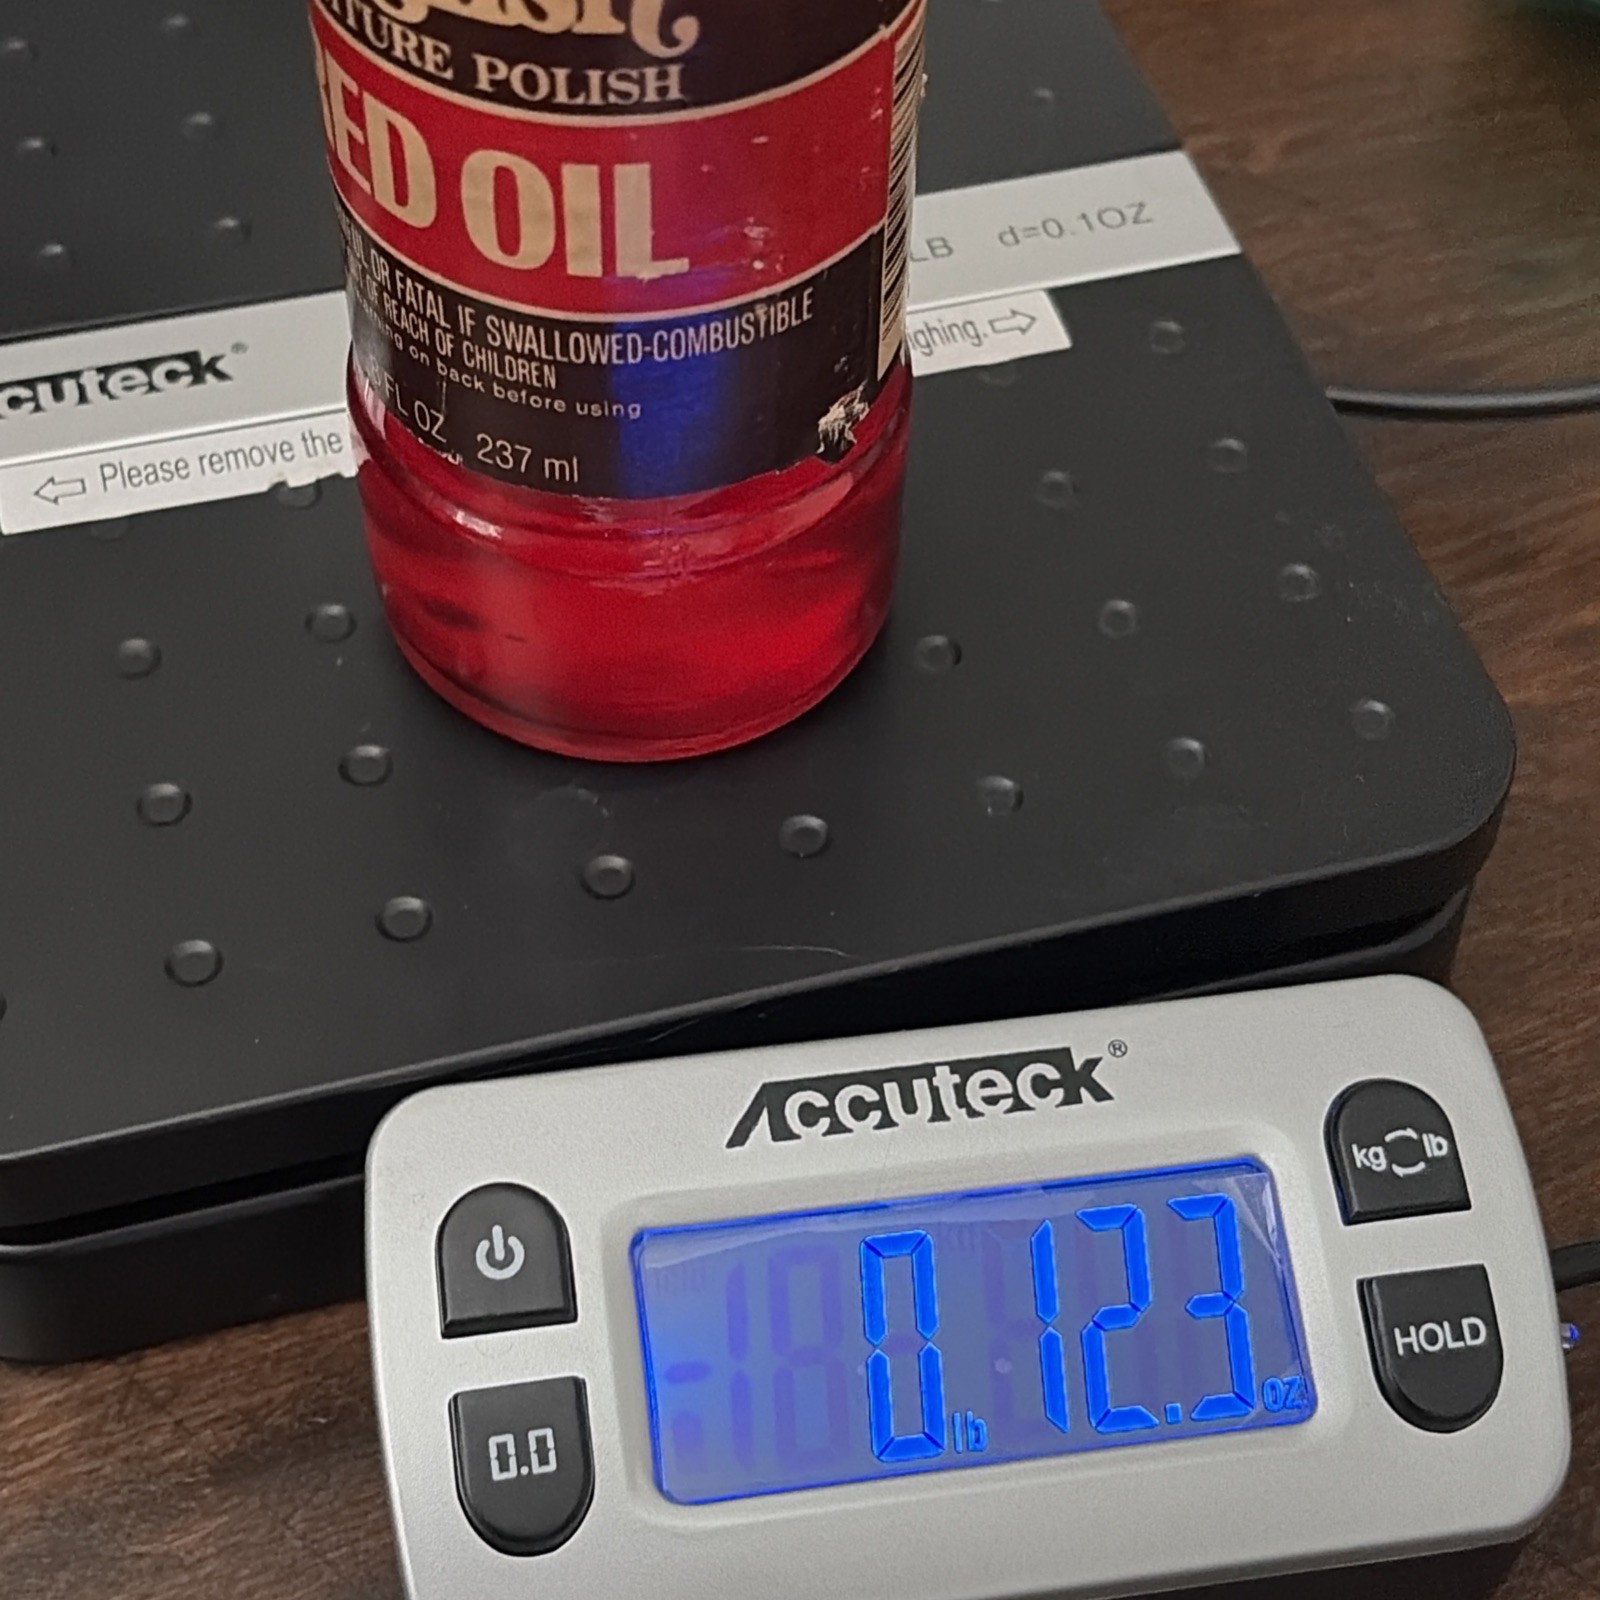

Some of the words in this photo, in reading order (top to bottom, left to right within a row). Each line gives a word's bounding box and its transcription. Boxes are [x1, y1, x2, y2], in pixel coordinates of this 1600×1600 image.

[472, 53, 684, 105] POLISH
[460, 148, 690, 278] OIL
[370, 248, 391, 291] OR
[395, 269, 451, 328] FATAL
[457, 304, 476, 337] IF
[383, 291, 430, 346] REACH
[435, 328, 454, 357] OF
[462, 341, 557, 390] CHILDREN
[409, 345, 430, 366] on
[436, 358, 485, 393] back
[493, 382, 567, 413] before
[575, 401, 642, 420] using
[99, 461, 190, 492] Please
[199, 442, 296, 476] remove
[301, 430, 343, 457] the
[414, 400, 448, 444] OZ
[476, 432, 533, 474] 237
[543, 455, 579, 484] ml
[1351, 1143, 1387, 1171] kg
[1422, 1132, 1449, 1158] lb
[859, 1229, 946, 1462] 0
[952, 1410, 988, 1454] lb
[1029, 1193, 1256, 1434] 12.3
[1394, 1316, 1487, 1356] HOLD
[488, 1426, 558, 1481] 0.0
